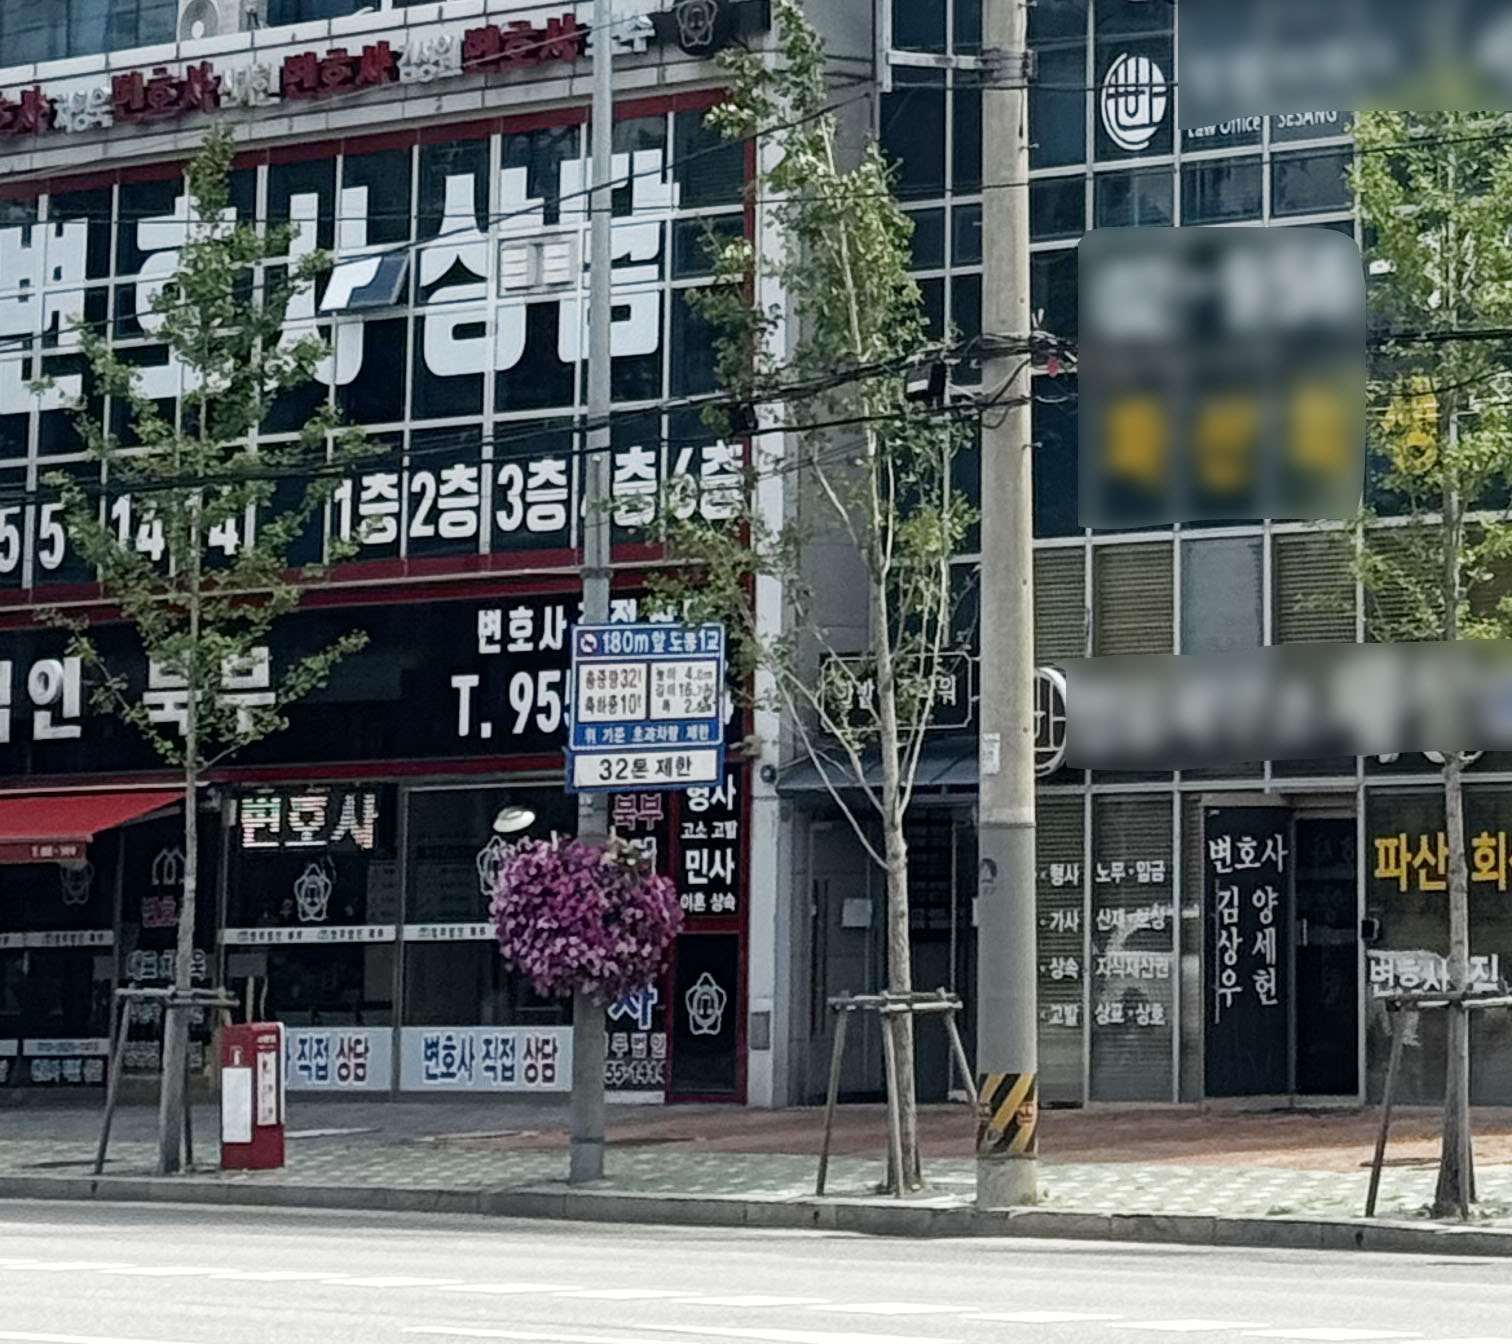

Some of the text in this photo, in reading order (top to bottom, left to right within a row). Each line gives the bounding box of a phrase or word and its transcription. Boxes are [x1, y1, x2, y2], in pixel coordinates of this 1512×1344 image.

[477, 605, 567, 655] 변호사
[598, 755, 693, 782] 32톤 제한
[241, 788, 379, 850] 변호사
[612, 792, 665, 832] 북부
[679, 820, 709, 840] 고소
[685, 847, 736, 886] 민사
[1208, 832, 1289, 874] 변호사
[1374, 831, 1450, 892] 파산
[1049, 863, 1080, 887] 형사
[679, 891, 707, 912] 이혼
[1049, 911, 1080, 932] 가사
[297, 1036, 370, 1083] 직접 상담
[423, 1033, 559, 1084] 변호사 직접 상담
